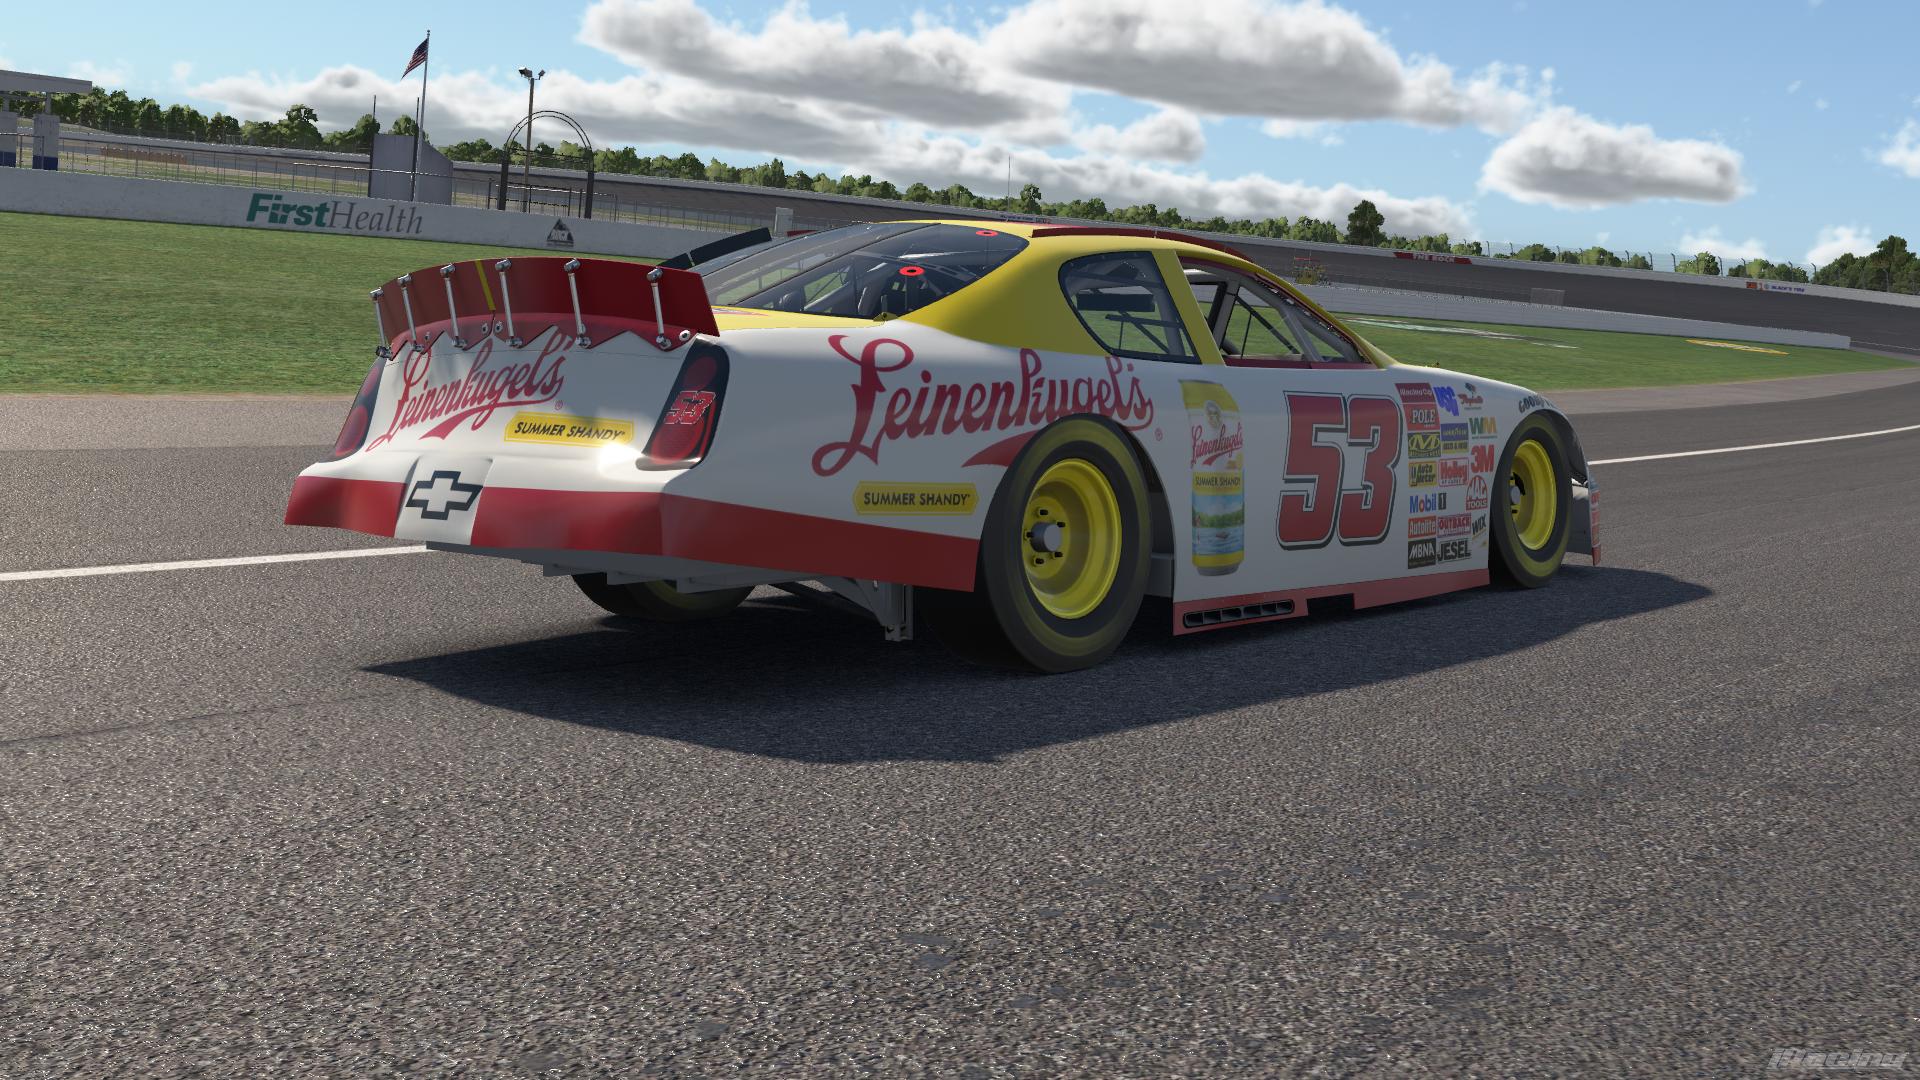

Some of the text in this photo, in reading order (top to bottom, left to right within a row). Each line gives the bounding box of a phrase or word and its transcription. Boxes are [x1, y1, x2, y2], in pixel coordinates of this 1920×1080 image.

[246, 193, 423, 234] FirstHealth
[663, 390, 716, 425] 53
[1433, 386, 1459, 416] USG
[1412, 409, 1436, 424] POLE
[1468, 416, 1497, 434] WM
[514, 421, 622, 441] SUMMER SHANDY
[1471, 444, 1494, 473] 3M
[1276, 390, 1403, 551] 53
[1417, 464, 1433, 474] Auto
[1440, 460, 1468, 482] Holley
[1195, 476, 1218, 486] SUMMER
[1467, 477, 1488, 500] MAC
[864, 491, 968, 506] SUMMER SHANDY
[1409, 493, 1437, 513] Mobil
[1467, 501, 1488, 509] TOOLS
[1409, 518, 1436, 536] Autolite
[1439, 517, 1470, 530] OUTBACK
[1472, 514, 1487, 536] WIX
[1409, 542, 1436, 559] MBNA
[1437, 540, 1471, 562] JESEL
